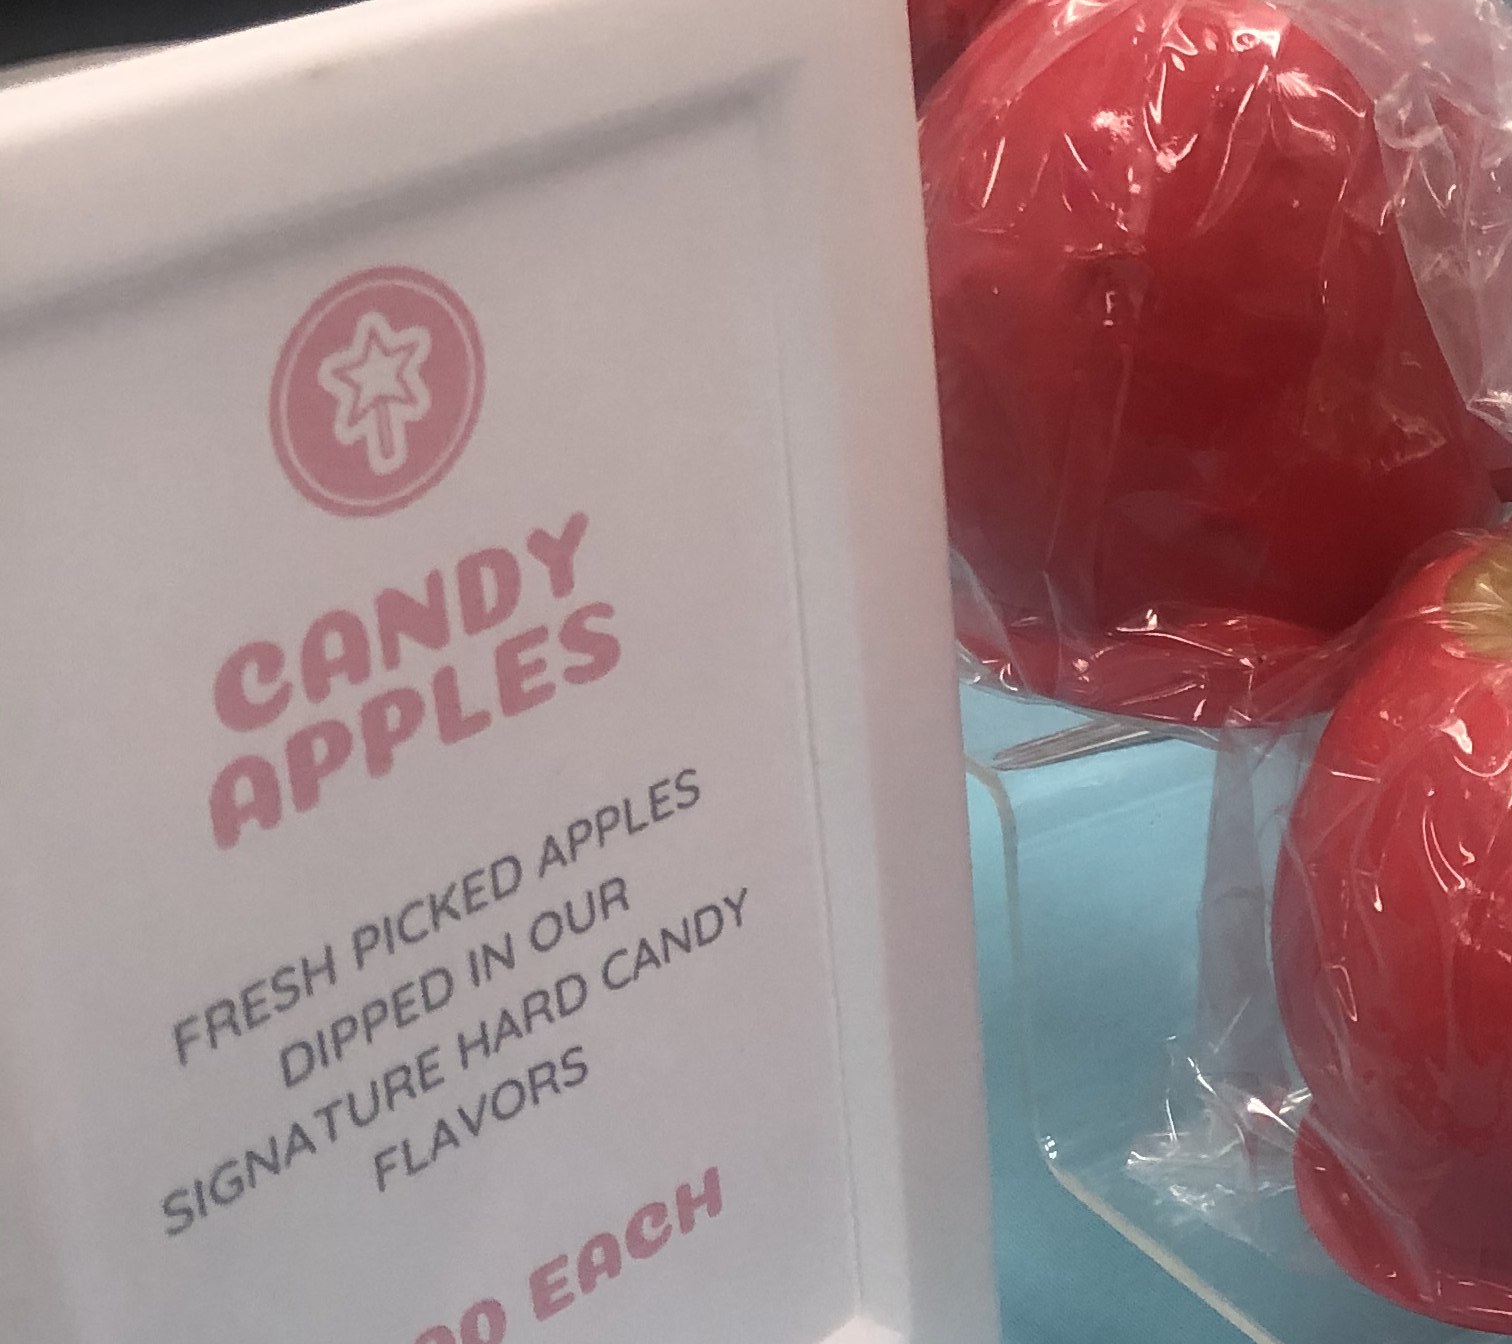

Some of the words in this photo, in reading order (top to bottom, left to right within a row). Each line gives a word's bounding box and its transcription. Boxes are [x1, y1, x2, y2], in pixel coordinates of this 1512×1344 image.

[207, 600, 623, 851] APPLES
[211, 510, 590, 733] CANDY
[170, 942, 338, 1069] FRESH
[350, 853, 524, 972] PICKED
[537, 766, 702, 880] APPLES
[278, 965, 456, 1091] DIPPED
[466, 930, 517, 989] IN
[527, 875, 631, 955] OUR
[160, 1042, 447, 1239] SIGNATURE
[456, 970, 589, 1072] HARD
[599, 885, 749, 992] CANDY
[372, 1043, 590, 1194] FLAVORS
[527, 1165, 724, 1323] EACH
